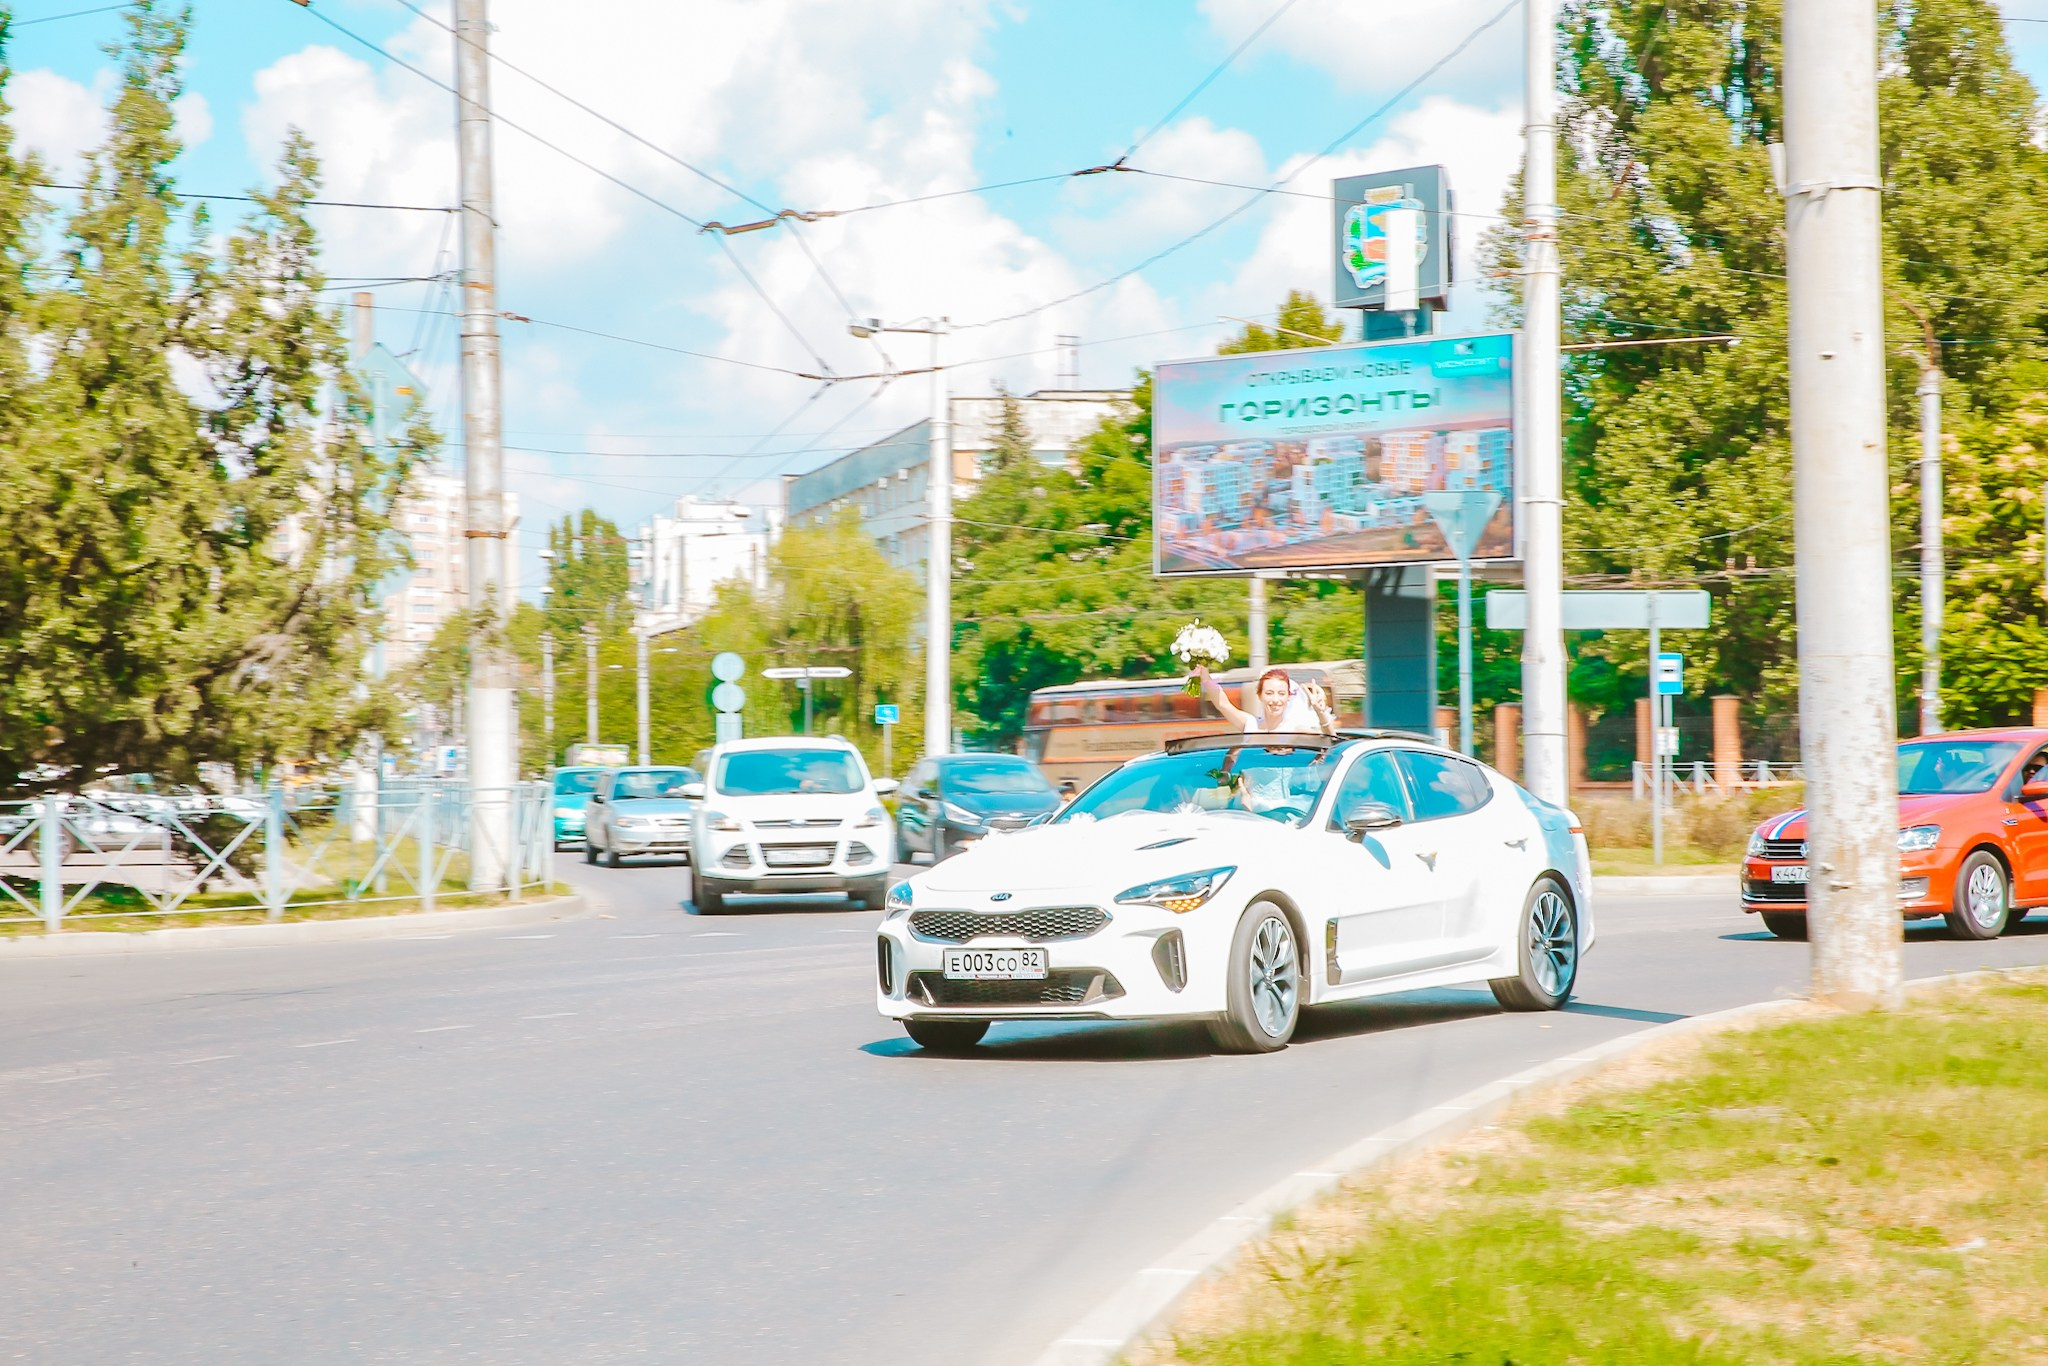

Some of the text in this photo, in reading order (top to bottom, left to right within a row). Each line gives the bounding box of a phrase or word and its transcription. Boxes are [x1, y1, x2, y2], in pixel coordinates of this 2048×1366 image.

[1247, 366, 1346, 388] ОТКРЫВАЕМ
[1353, 360, 1413, 379] НОВЫЕ
[1219, 388, 1441, 423] ГОРИЗОНТЫ
[991, 892, 1010, 901] KIA
[1022, 952, 1038, 966] 82
